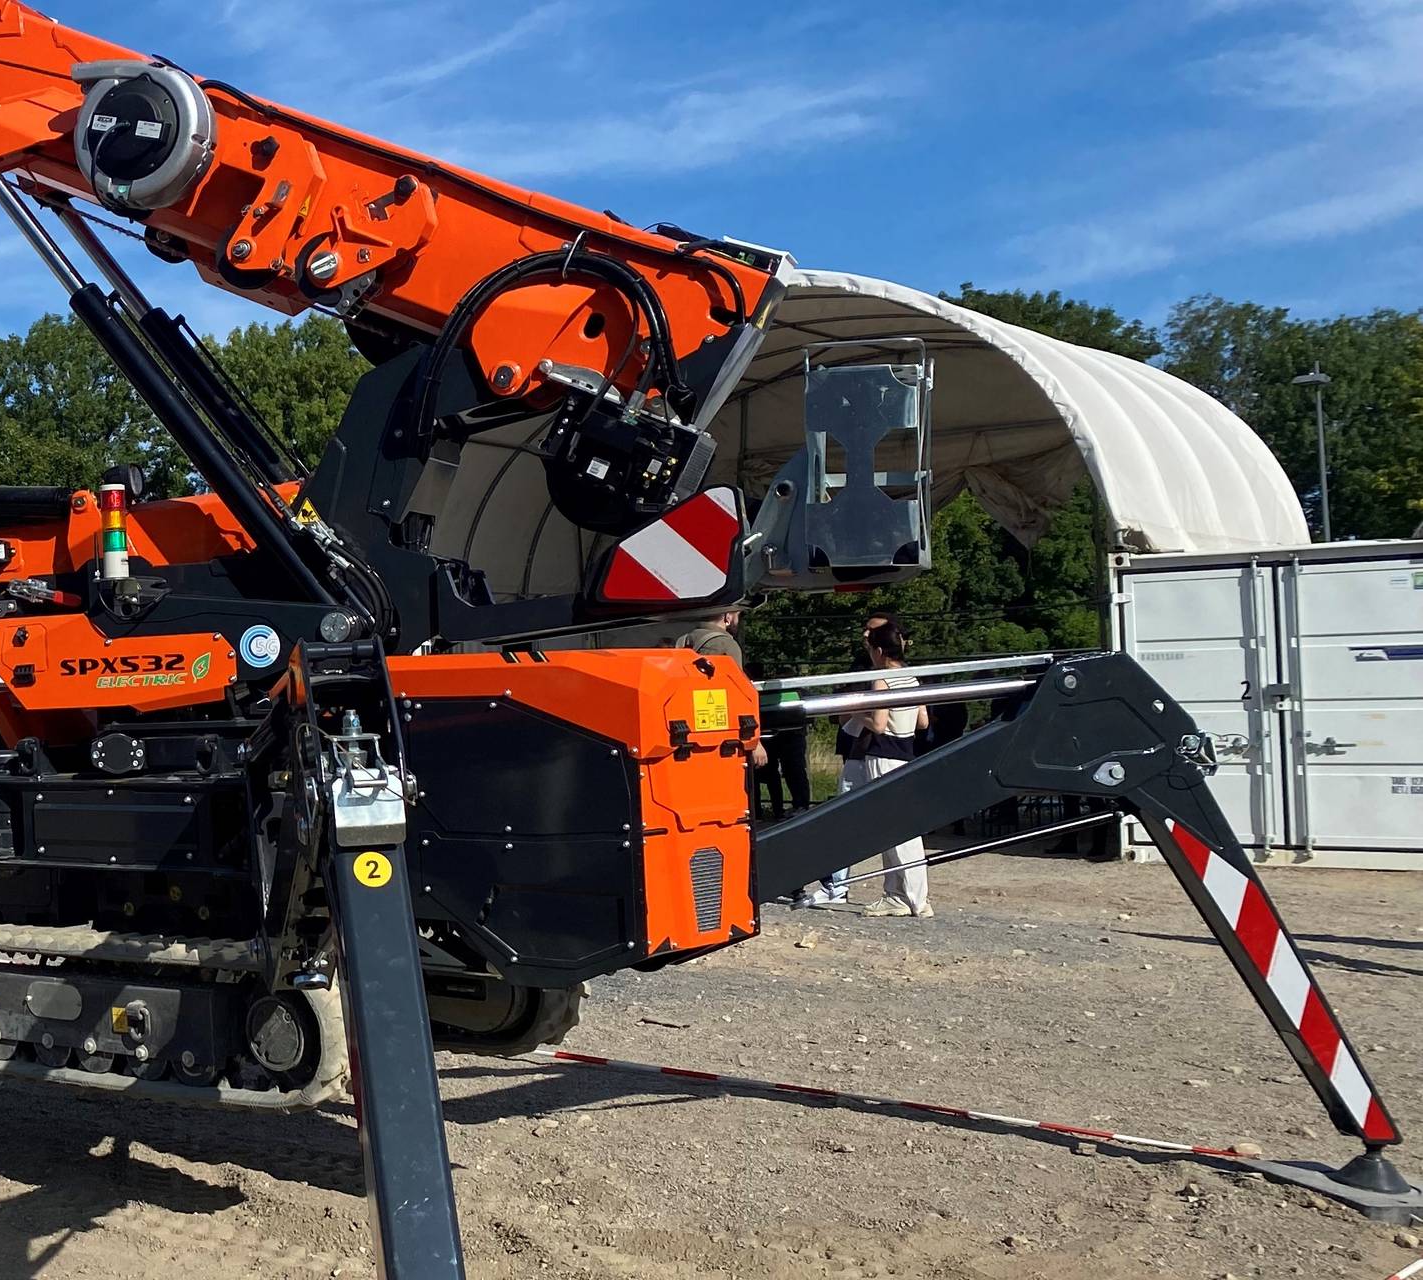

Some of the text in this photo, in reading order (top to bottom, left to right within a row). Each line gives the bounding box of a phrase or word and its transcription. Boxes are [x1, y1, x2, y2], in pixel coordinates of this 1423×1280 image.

[256, 638, 279, 656] 5G
[60, 653, 186, 677] SPX532
[96, 672, 188, 689] ELECTRIC
[1240, 680, 1252, 700] 2
[365, 859, 381, 879] 2
